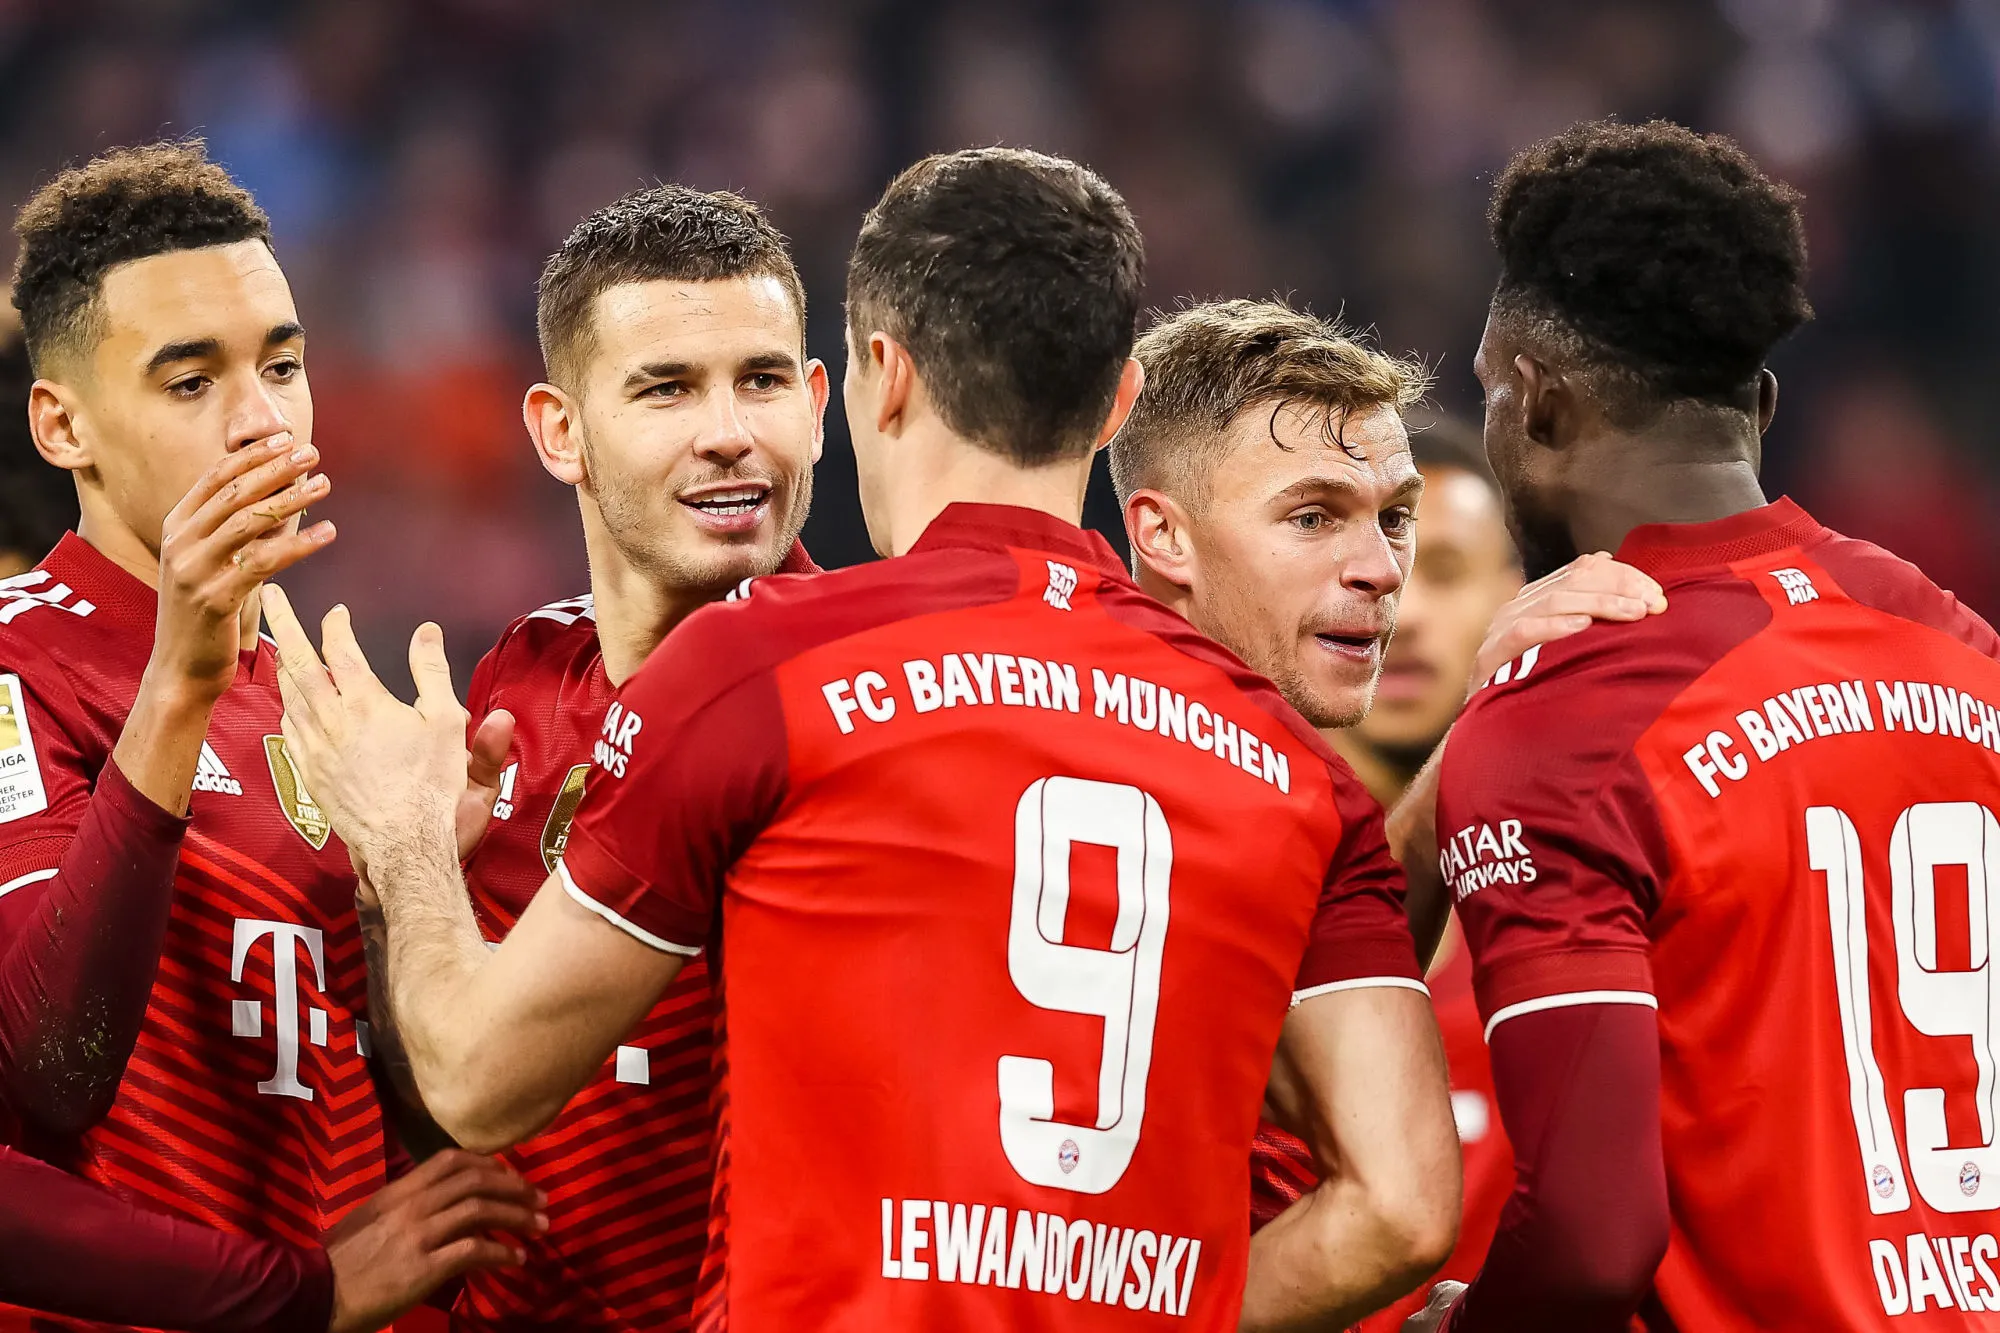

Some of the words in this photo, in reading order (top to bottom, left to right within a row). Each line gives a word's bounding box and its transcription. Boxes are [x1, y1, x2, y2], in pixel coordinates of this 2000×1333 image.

[1786, 584, 1819, 606] MIA
[821, 670, 896, 735] FC
[902, 652, 1081, 714] BAYERN
[1092, 668, 1291, 795] MÜNCHEN
[1682, 730, 1749, 799] FC
[1735, 680, 1875, 763] BAYERN
[1875, 680, 2000, 755] MÜNCH
[1439, 819, 1531, 887] QATAR
[1455, 858, 1537, 903] AIRWAYS
[231, 918, 326, 1101] T
[997, 775, 1174, 1195] 9
[1804, 801, 2000, 1215] 19
[881, 1197, 1202, 1317] LEWANDOWSKI
